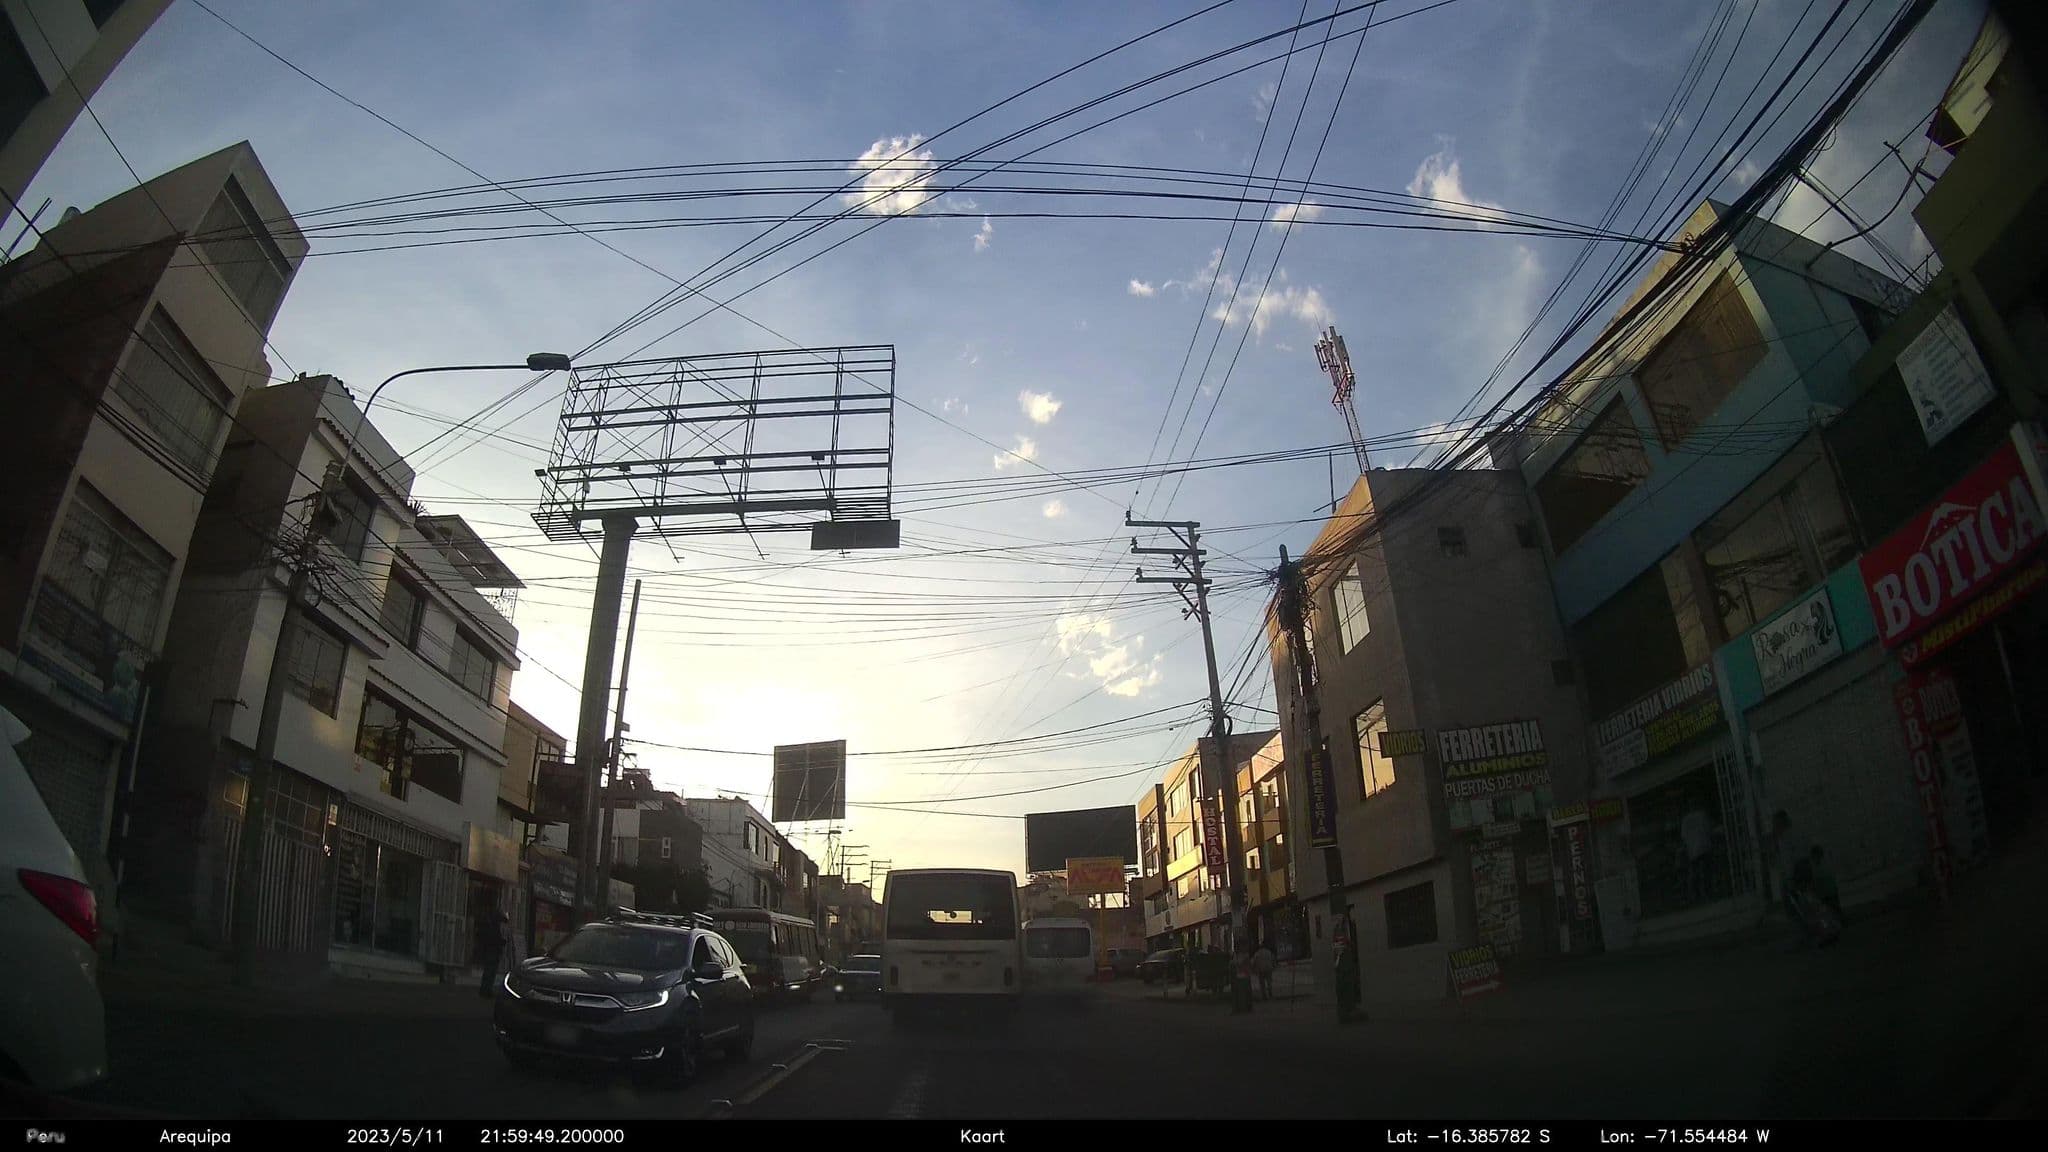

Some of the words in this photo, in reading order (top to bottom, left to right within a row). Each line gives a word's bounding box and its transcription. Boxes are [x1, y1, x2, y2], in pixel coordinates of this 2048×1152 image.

[1873, 475, 2048, 640] BOTICA
[1599, 692, 1663, 745] FERRETERIA
[1661, 663, 1713, 710] VIDRIOS
[1382, 731, 1426, 757] VIDRIOS
[1439, 720, 1545, 762] FERRETERIA
[1444, 777, 1496, 798] PUERTAS
[1497, 774, 1512, 791] DE
[1514, 768, 1552, 788] DUCHA
[1906, 716, 1953, 907] BOTIC
[1206, 807, 1222, 866] HOSTAL
[1567, 826, 1593, 918] PERNOS
